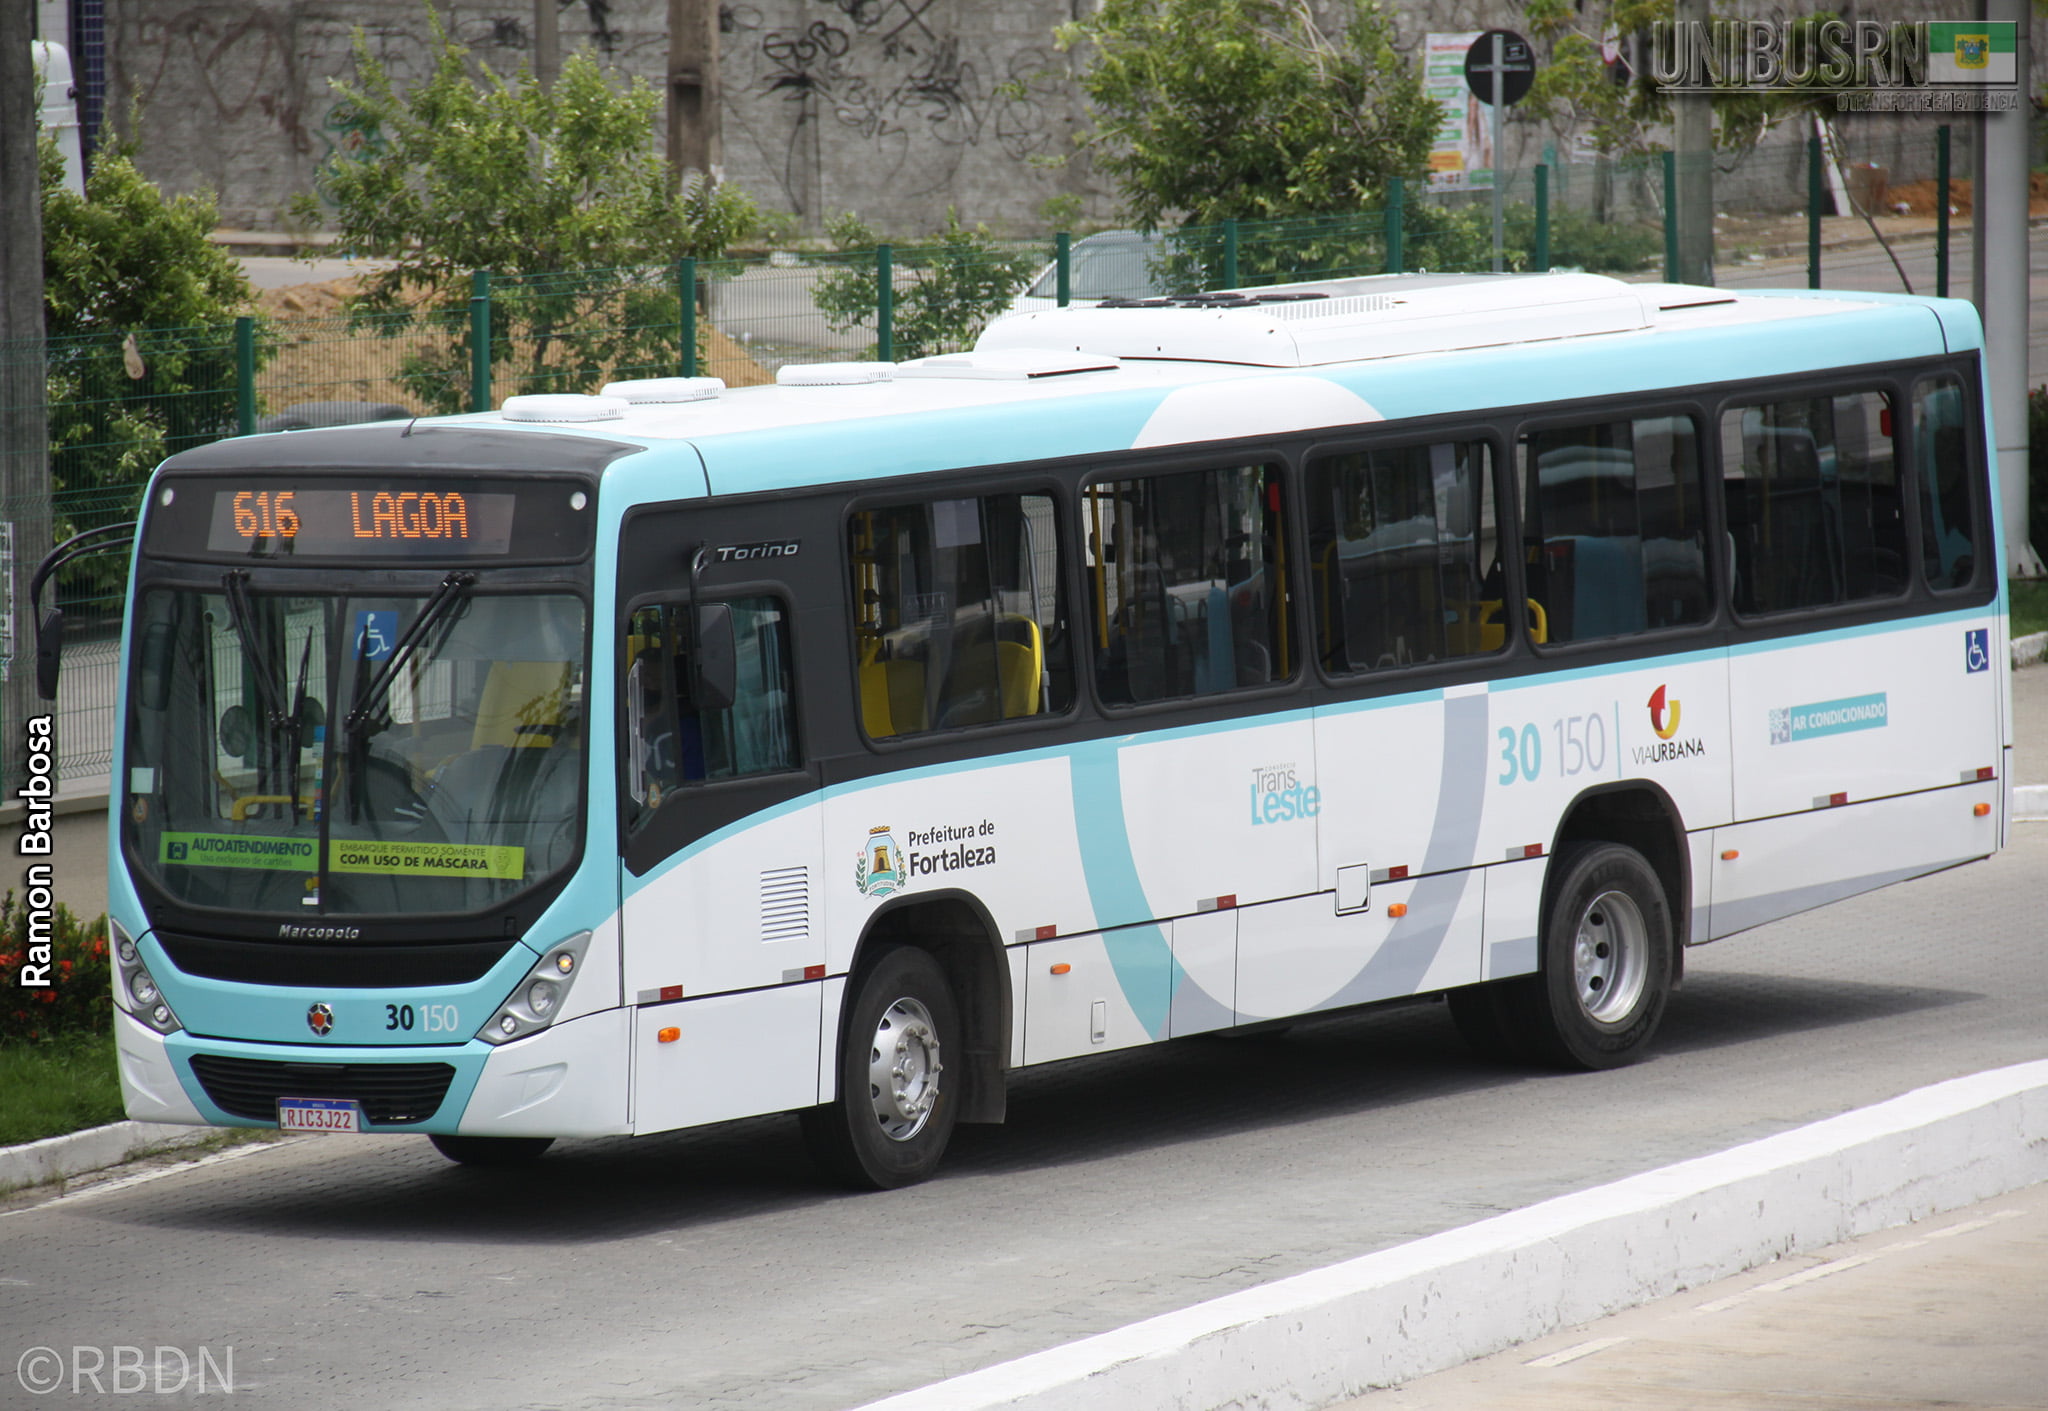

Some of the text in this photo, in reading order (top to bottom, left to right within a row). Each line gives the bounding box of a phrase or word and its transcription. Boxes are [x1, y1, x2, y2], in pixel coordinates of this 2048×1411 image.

[233, 491, 468, 538] 616 LAGOA
[717, 543, 799, 561] Torino
[1793, 702, 1886, 731] AR CONDICIONADO
[1498, 712, 1606, 786] 30 150
[1252, 767, 1297, 794] Trans
[1250, 780, 1321, 826] Leste
[908, 819, 995, 847] Prefeitura de
[191, 838, 313, 857] AUTOATENDIMENTO
[252, 857, 262, 865] de
[340, 843, 487, 857] EMBARQUE PERMITIDO SOMENTE
[909, 843, 996, 877] Fortaleza
[340, 854, 488, 870] COM USO DE MÁSCARA
[279, 924, 360, 939] Marcopolo
[385, 1004, 459, 1032] 30 150
[287, 1109, 352, 1129] RIC3J22
